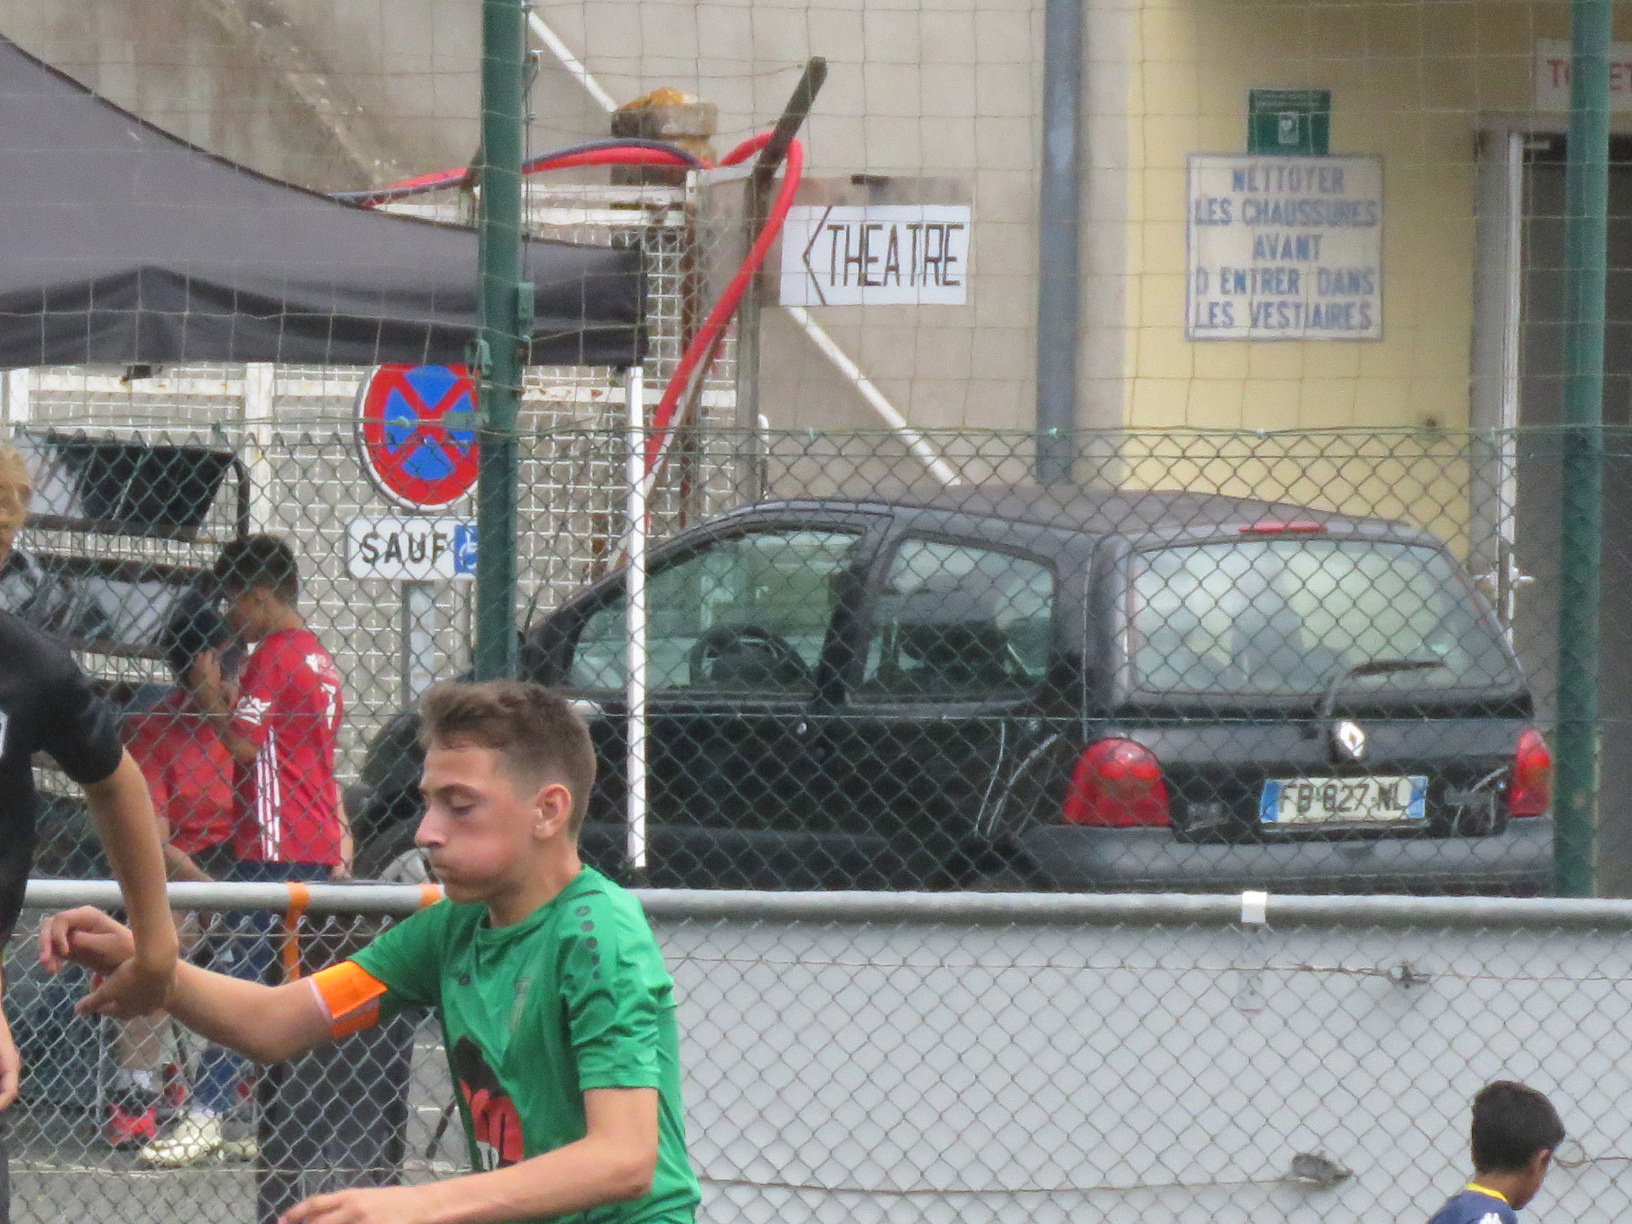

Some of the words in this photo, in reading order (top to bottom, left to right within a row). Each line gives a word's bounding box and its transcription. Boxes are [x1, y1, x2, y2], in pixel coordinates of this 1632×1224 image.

[1195, 198, 1233, 226] LES
[827, 224, 965, 287] THEATRE
[1252, 232, 1323, 261] AVANT
[1317, 267, 1375, 297] DANS
[1195, 302, 1235, 328] LES
[360, 531, 447, 564] SAUF
